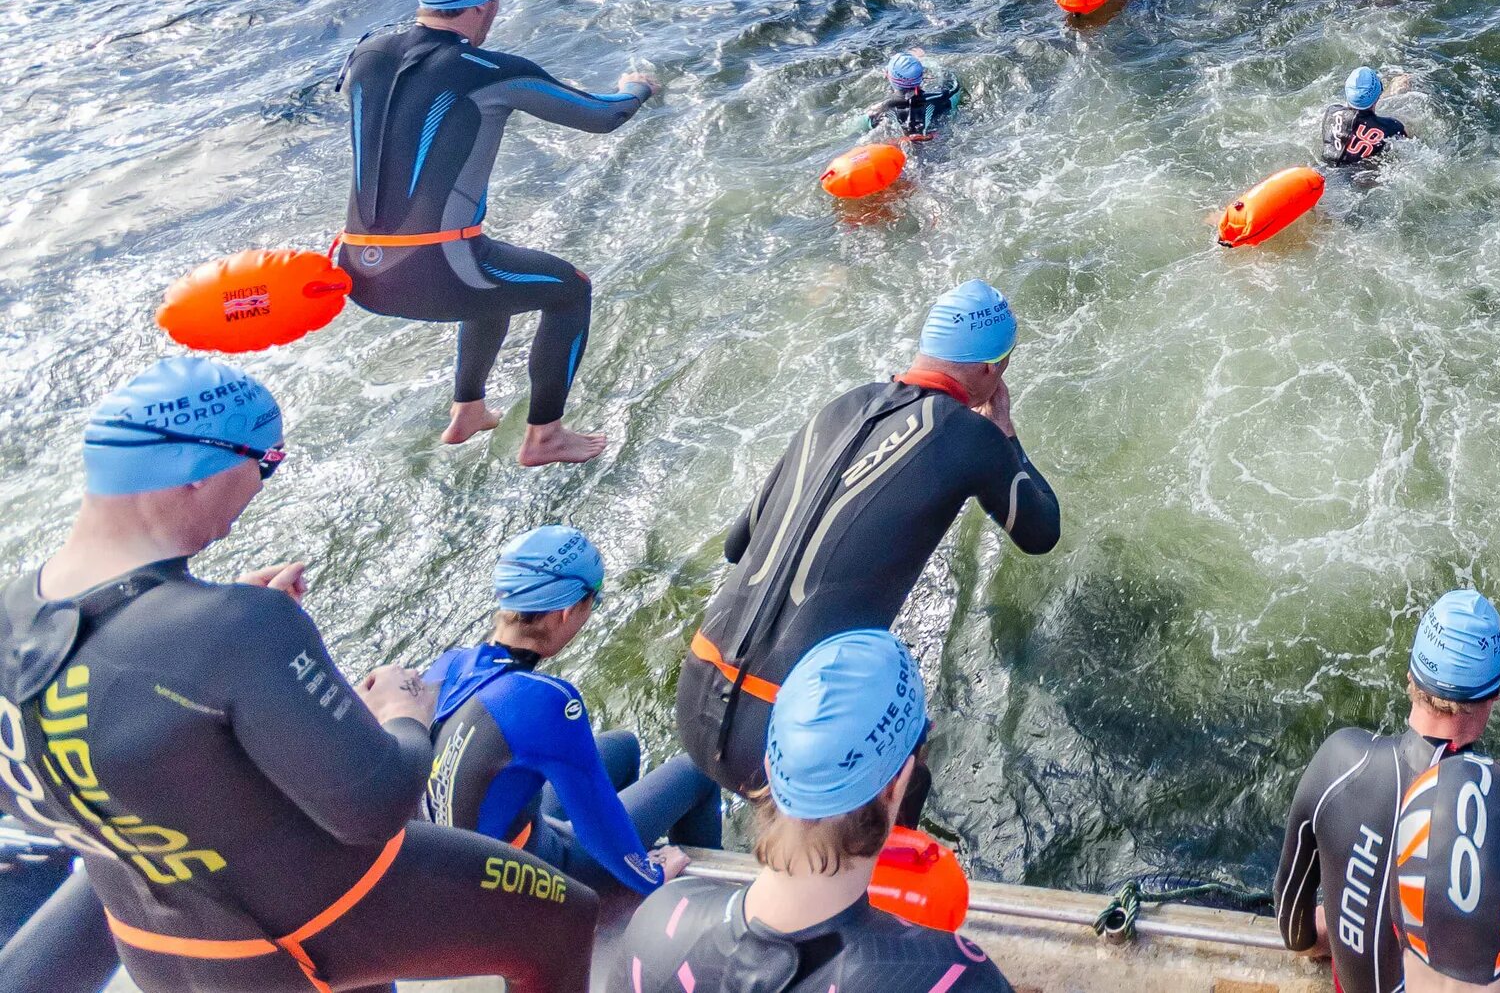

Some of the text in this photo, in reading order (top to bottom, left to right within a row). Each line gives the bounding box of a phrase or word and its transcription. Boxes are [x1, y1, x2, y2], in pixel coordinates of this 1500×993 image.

[225, 306, 270, 322] SWIM
[969, 308, 991, 321] THE
[970, 313, 1006, 331] FJORD
[144, 397, 190, 416] THE
[841, 414, 918, 487] 2XU
[1424, 624, 1445, 651] SWIM
[865, 702, 899, 743] THE
[875, 687, 917, 756] FJORD
[480, 857, 566, 903] sonar
[1339, 824, 1383, 954] HUUB
